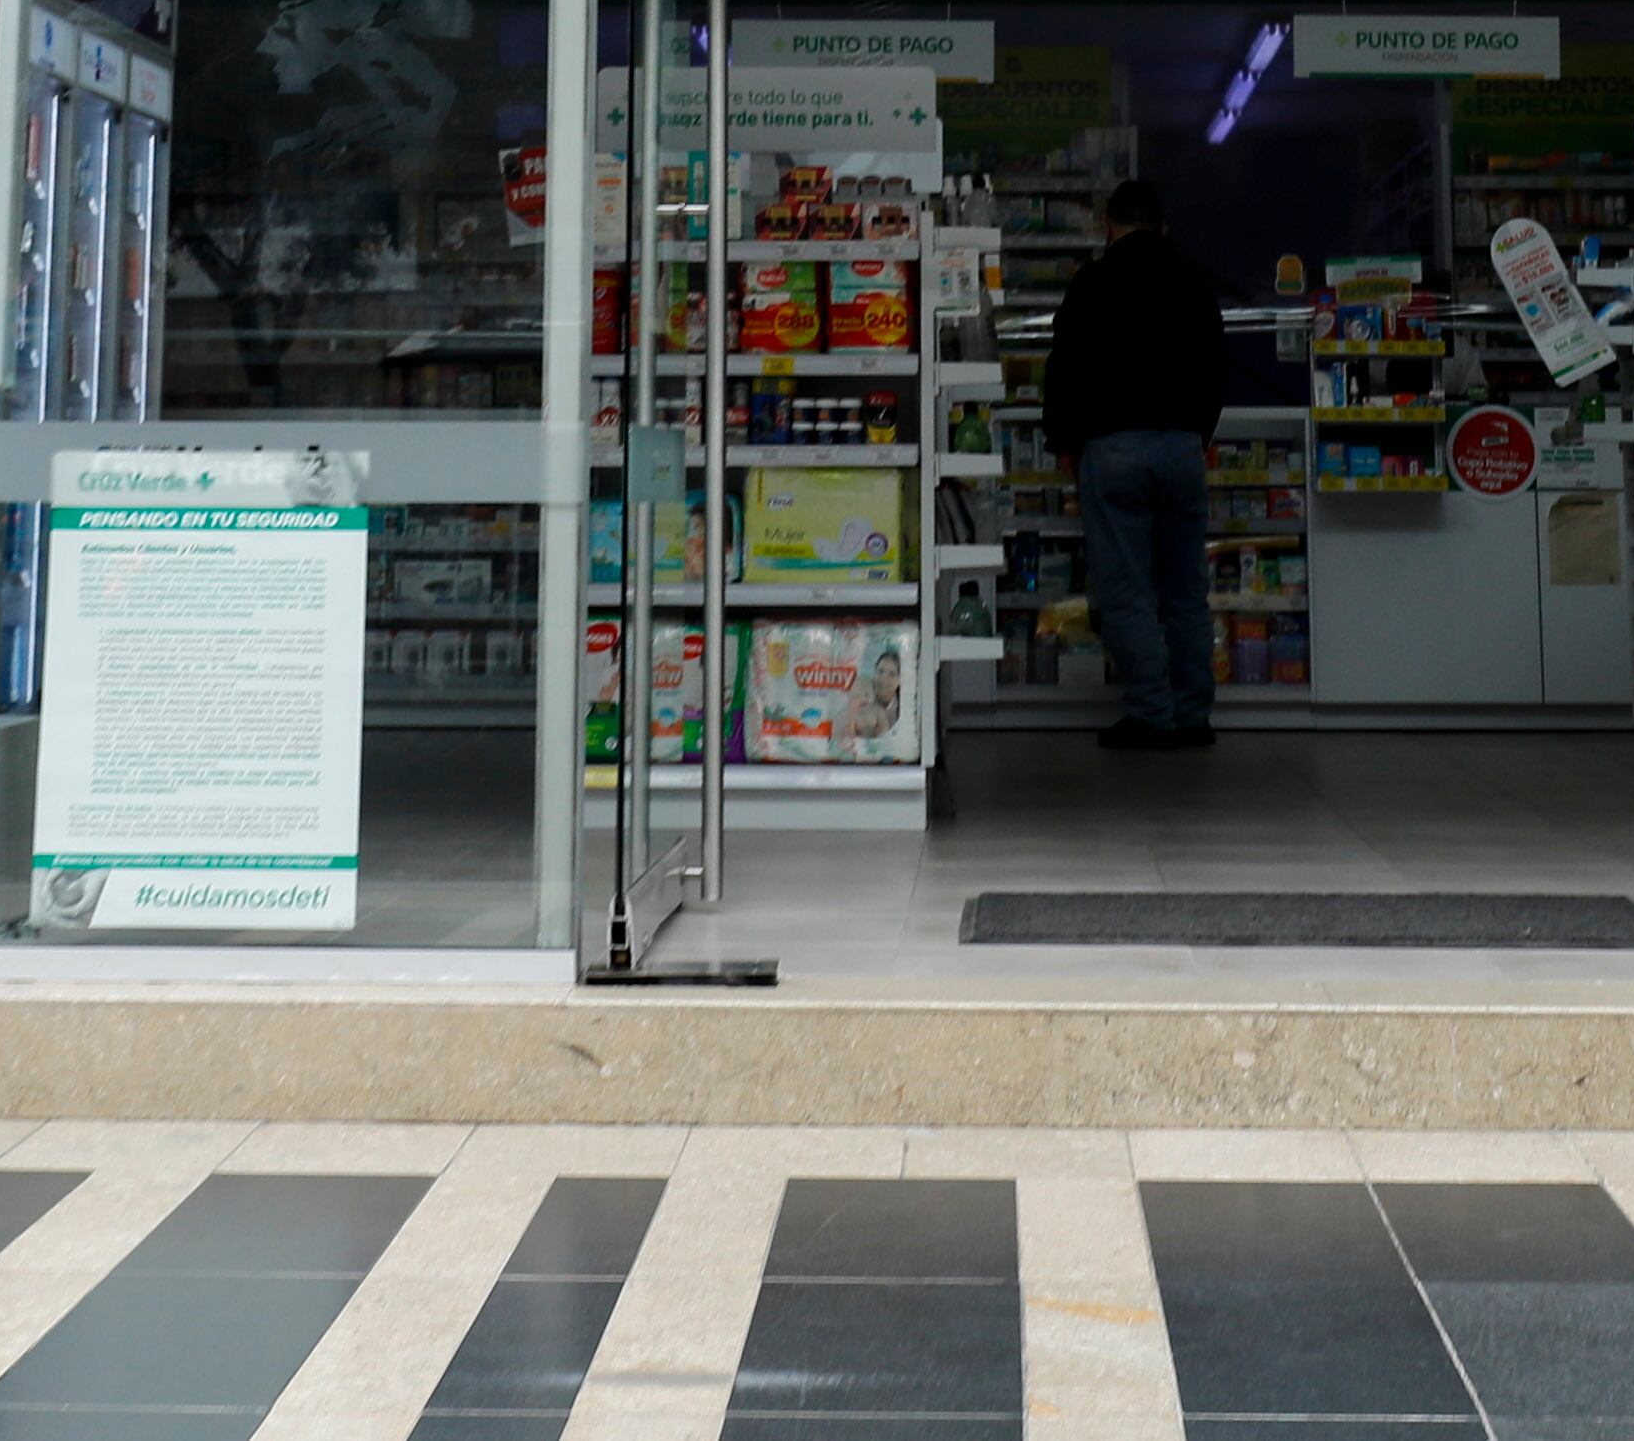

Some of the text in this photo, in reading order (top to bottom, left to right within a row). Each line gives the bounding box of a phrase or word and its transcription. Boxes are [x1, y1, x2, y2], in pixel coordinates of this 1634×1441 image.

[792, 35, 954, 54] PUNTO DE PAGO
[1355, 31, 1519, 49] PUNTO DE PAGO
[747, 89, 844, 109] todo lo que
[763, 111, 808, 127] tiene
[811, 114, 851, 129] para
[867, 312, 906, 329] 240
[79, 510, 341, 528] PENSANDO EN TU SEGURIDAD
[796, 663, 856, 690] winny
[133, 882, 333, 910] #cuidamosdeti
